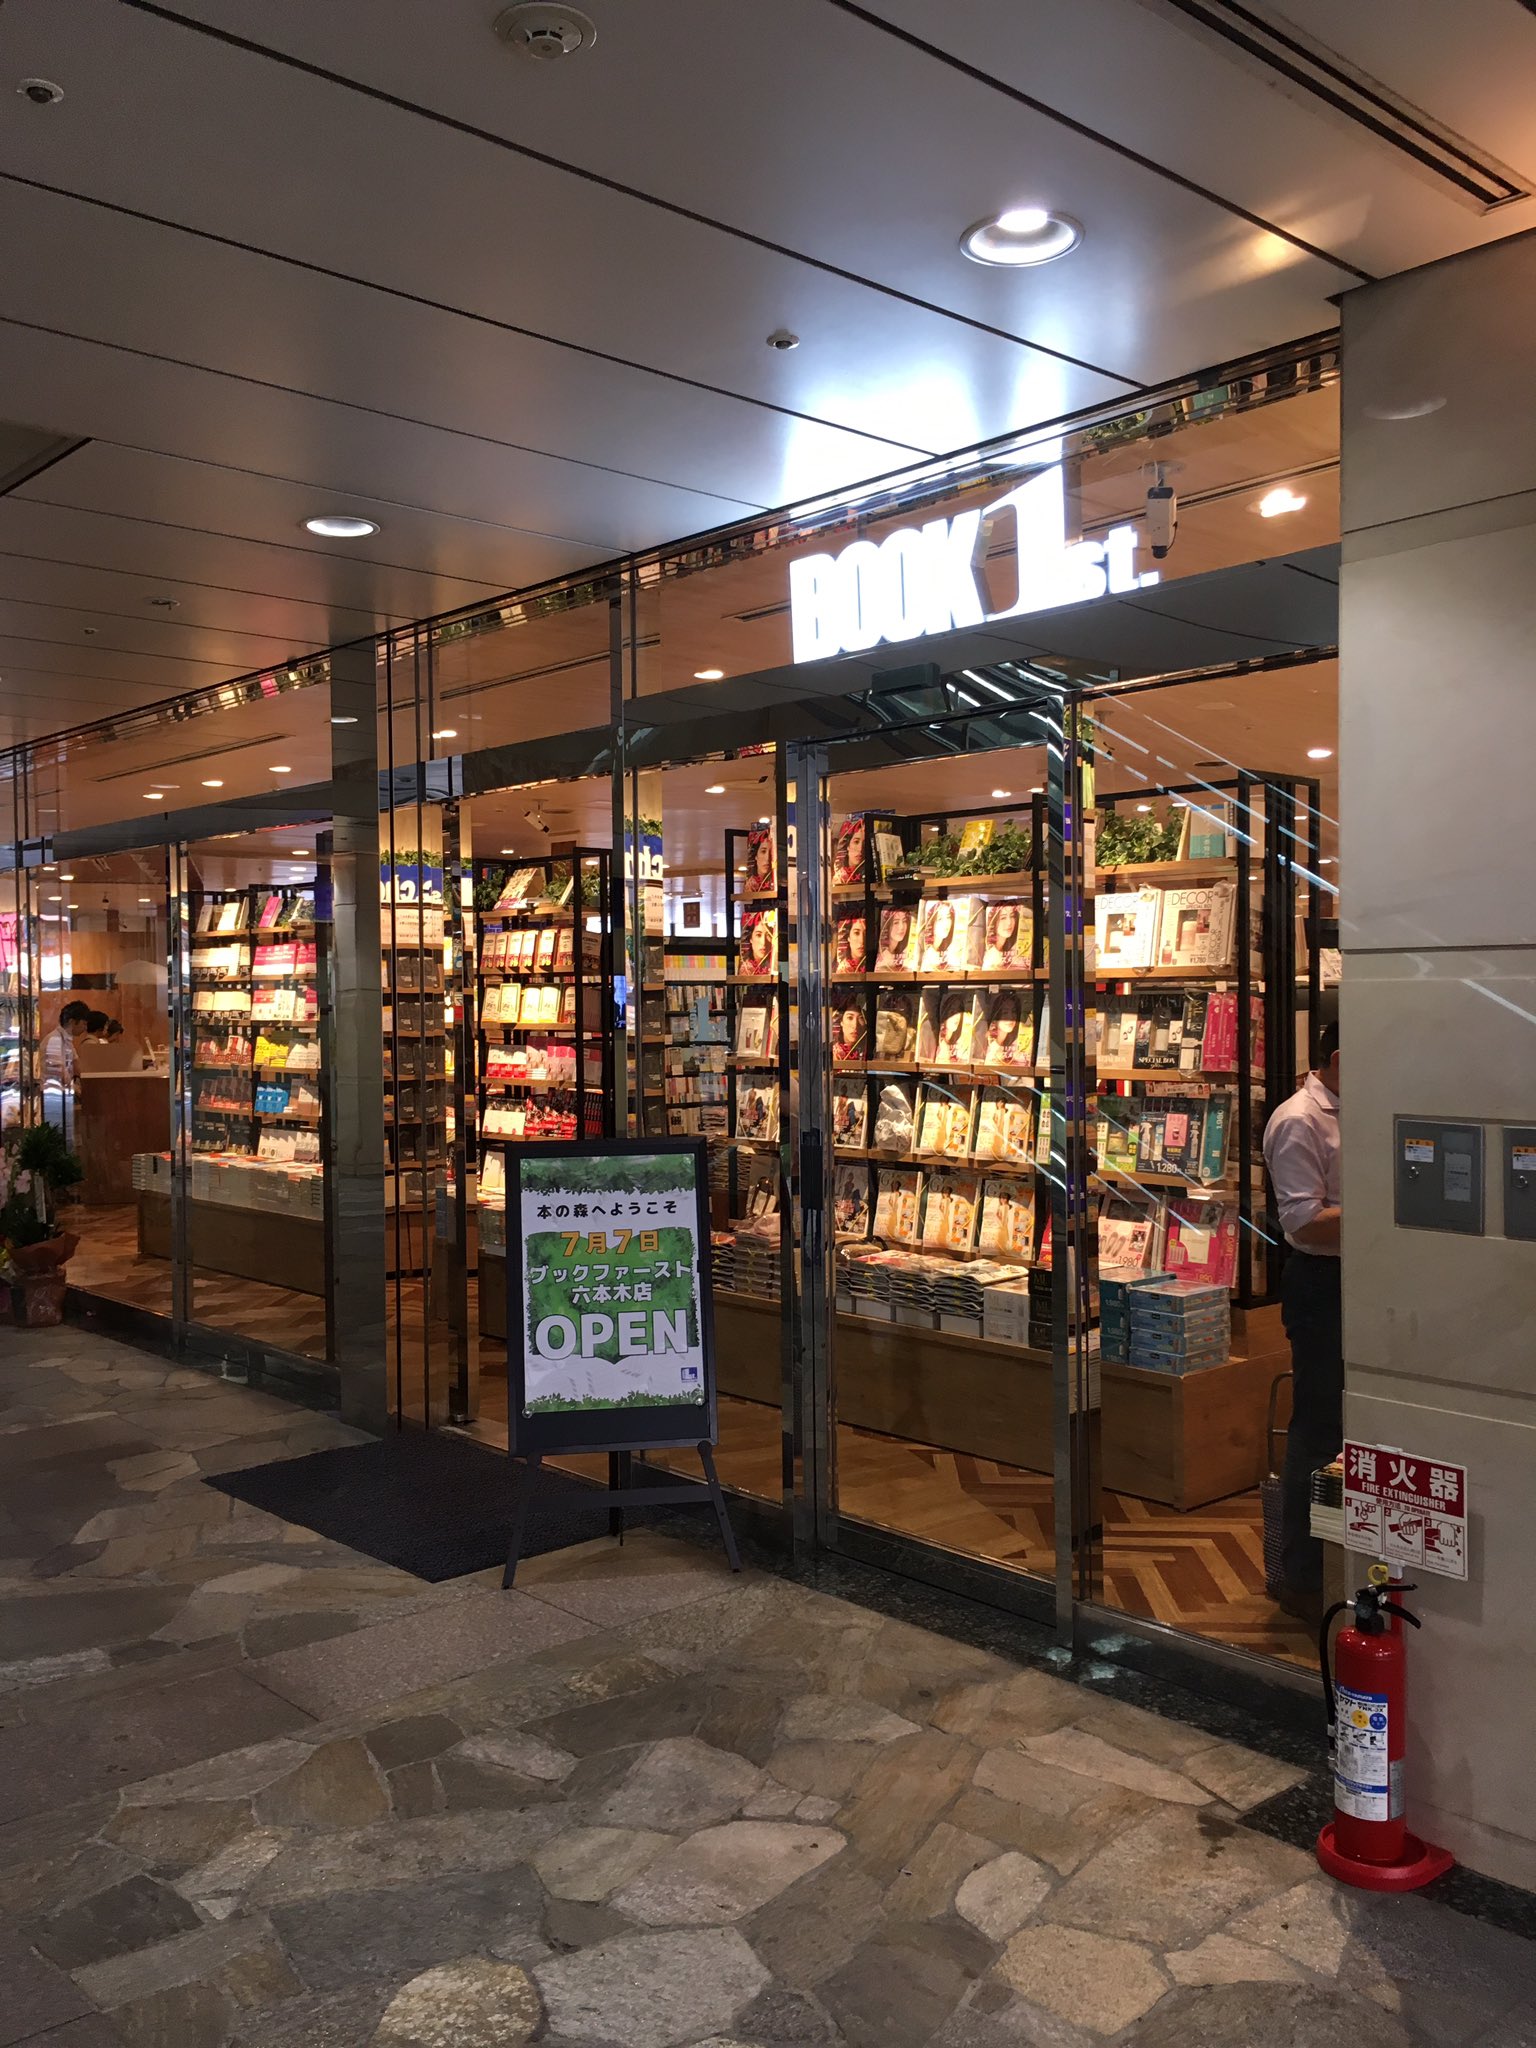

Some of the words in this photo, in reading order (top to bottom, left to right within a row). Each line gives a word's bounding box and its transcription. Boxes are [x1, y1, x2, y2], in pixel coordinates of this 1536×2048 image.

[790, 509, 985, 664] BOOK
[537, 1201, 677, 1219] 本の森へようこそ
[560, 1229, 660, 1257] 7月7日
[530, 1261, 691, 1284] ブックファースト
[571, 1282, 652, 1304] 六本木店
[535, 1309, 689, 1360] OPEN
[1349, 1448, 1459, 1502] 消火器
[1361, 1481, 1380, 1494] FIRE
[1382, 1486, 1446, 1511] EXTINGUISHER
